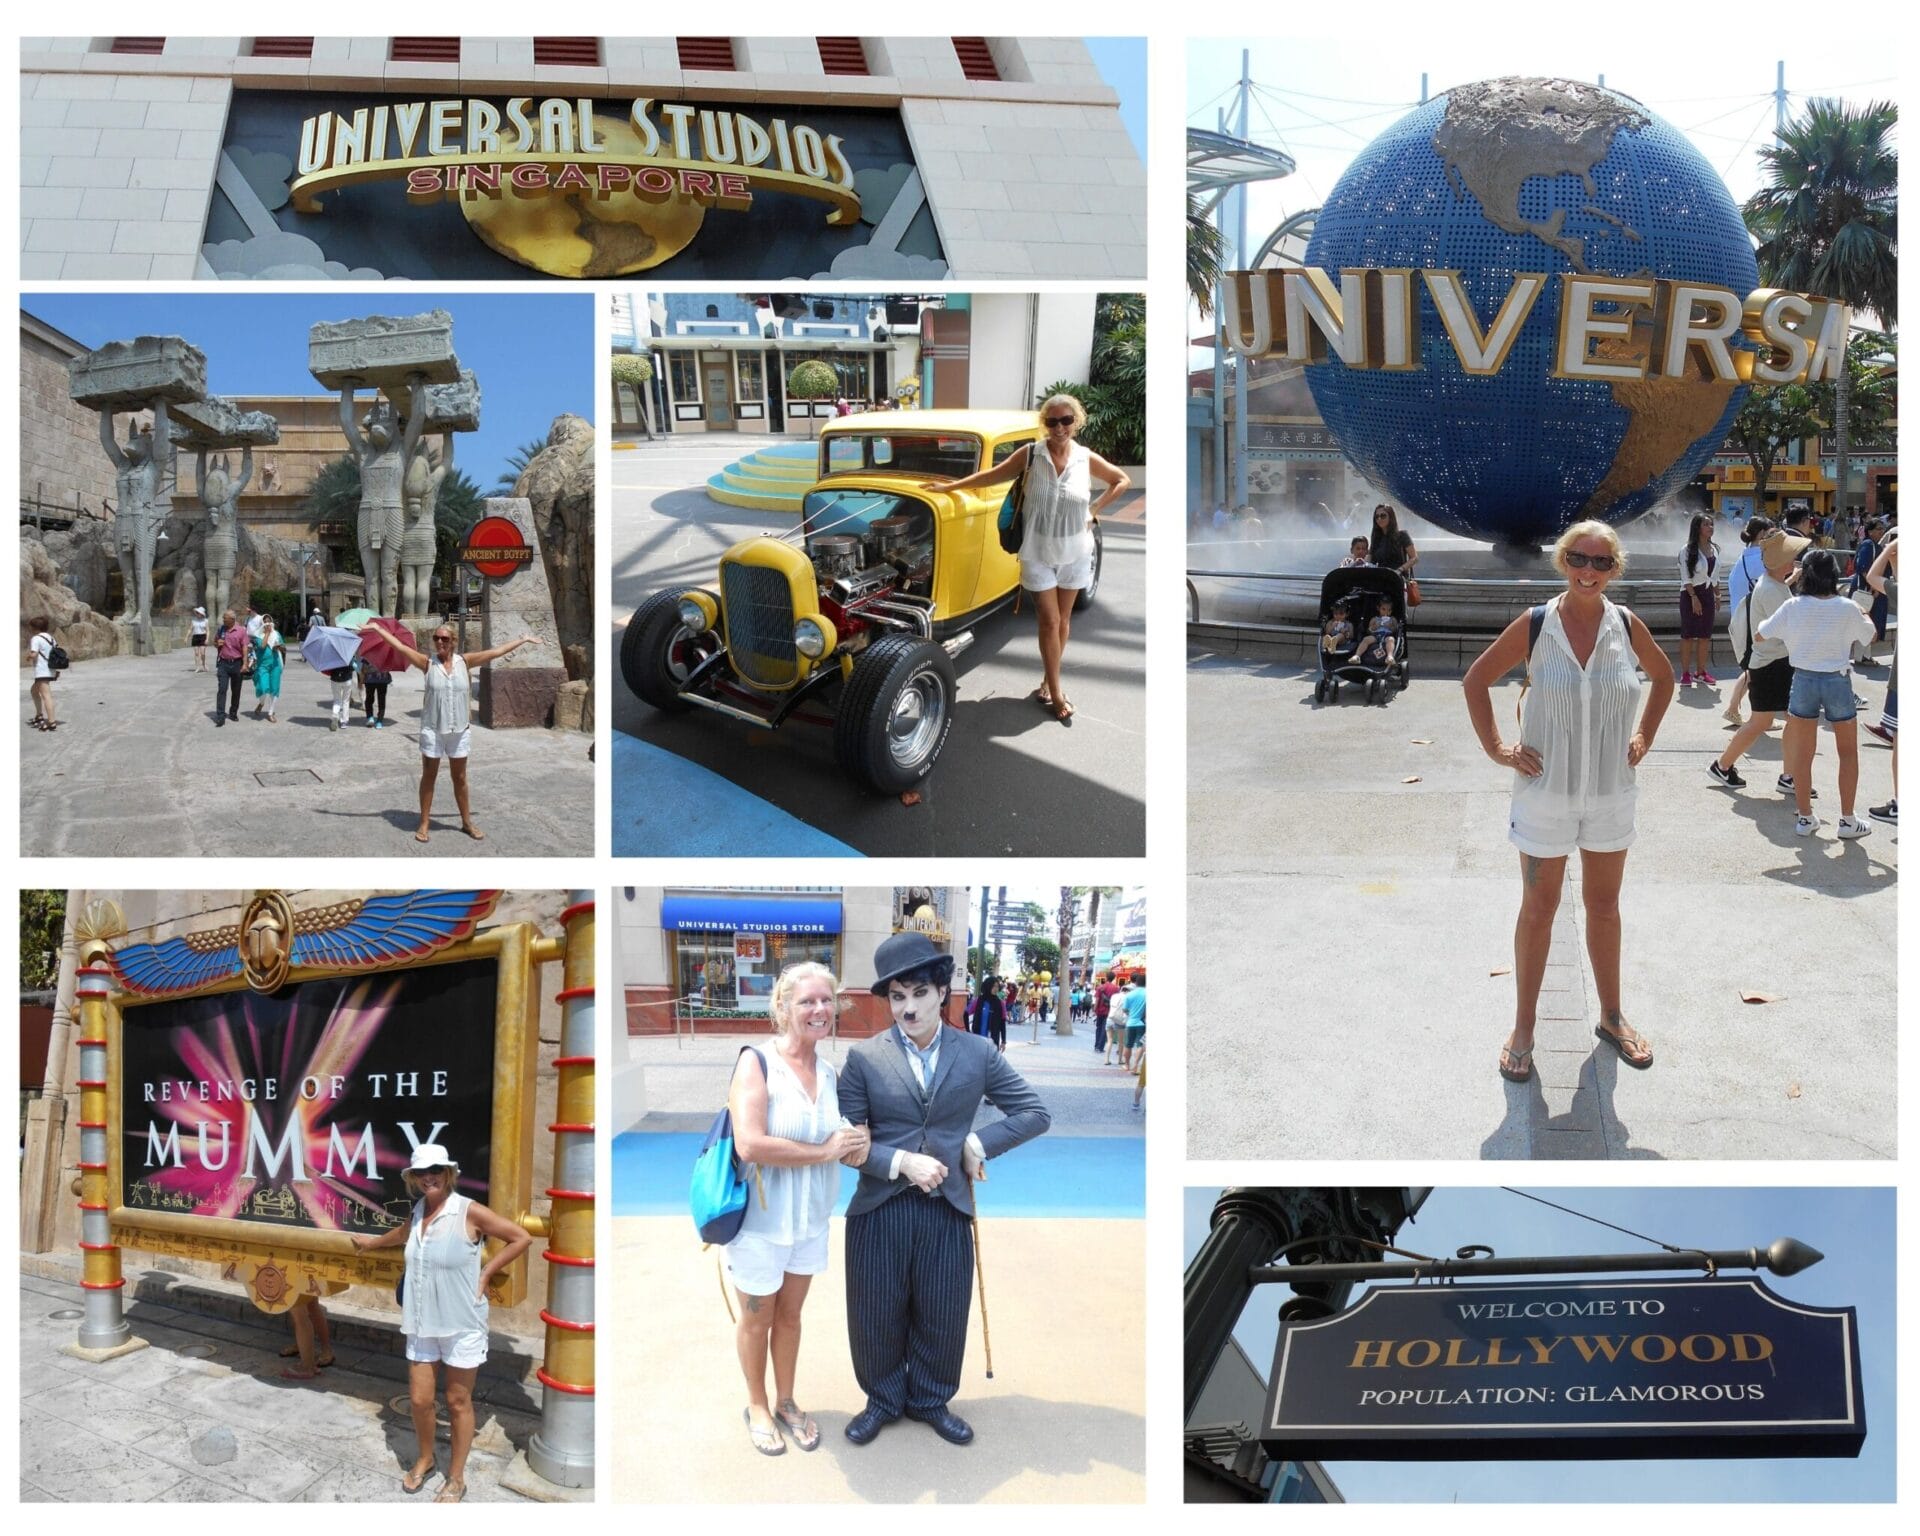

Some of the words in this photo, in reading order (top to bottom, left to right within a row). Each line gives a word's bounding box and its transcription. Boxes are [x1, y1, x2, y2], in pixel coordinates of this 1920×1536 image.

[299, 97, 602, 176] UNIVERSAL
[629, 97, 855, 189] STUDIOS
[406, 162, 755, 200] SINGAPORE
[463, 549, 501, 560] ANCIENT
[503, 549, 531, 559] EGYPT
[677, 920, 739, 931] UNIVERSAL
[742, 922, 788, 932] STUDIOS
[791, 923, 825, 932] STORE
[143, 1077, 278, 1102] REVENGE
[300, 1074, 346, 1099] OF
[368, 1069, 449, 1099] THE
[1457, 1301, 1617, 1321] WELCOME
[1622, 1299, 1666, 1317] TO
[1346, 1332, 1775, 1370] HOLLYWOOD
[1356, 1386, 1557, 1407] POPULATION:
[1564, 1383, 1766, 1403] GLAMOROUS
